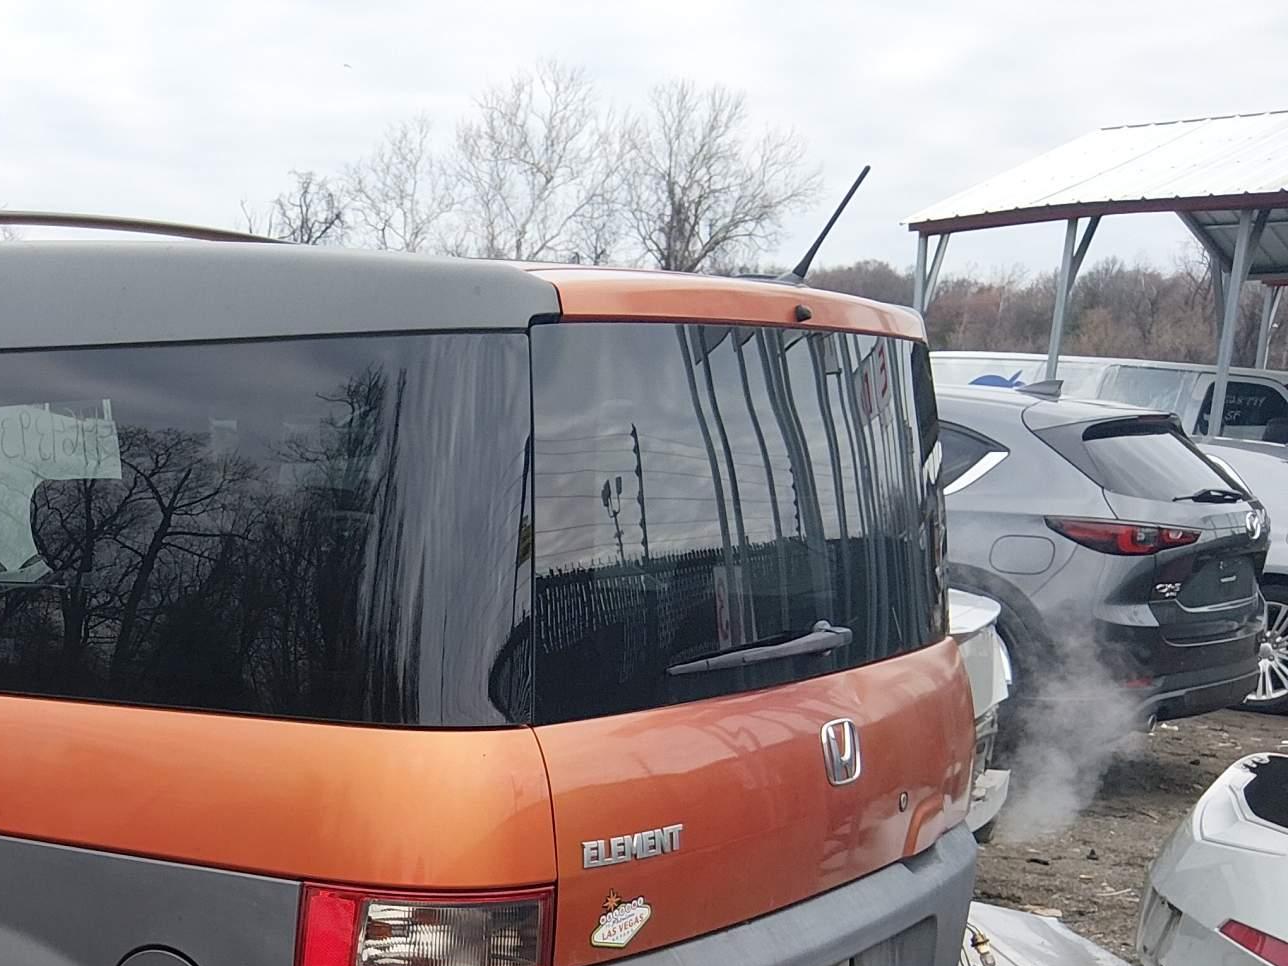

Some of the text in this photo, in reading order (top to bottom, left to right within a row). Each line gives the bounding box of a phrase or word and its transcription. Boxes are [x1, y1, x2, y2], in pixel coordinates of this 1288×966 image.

[582, 824, 683, 869] ELEMENT
[602, 926, 617, 941] LAS
[618, 912, 644, 933] VEGAS
